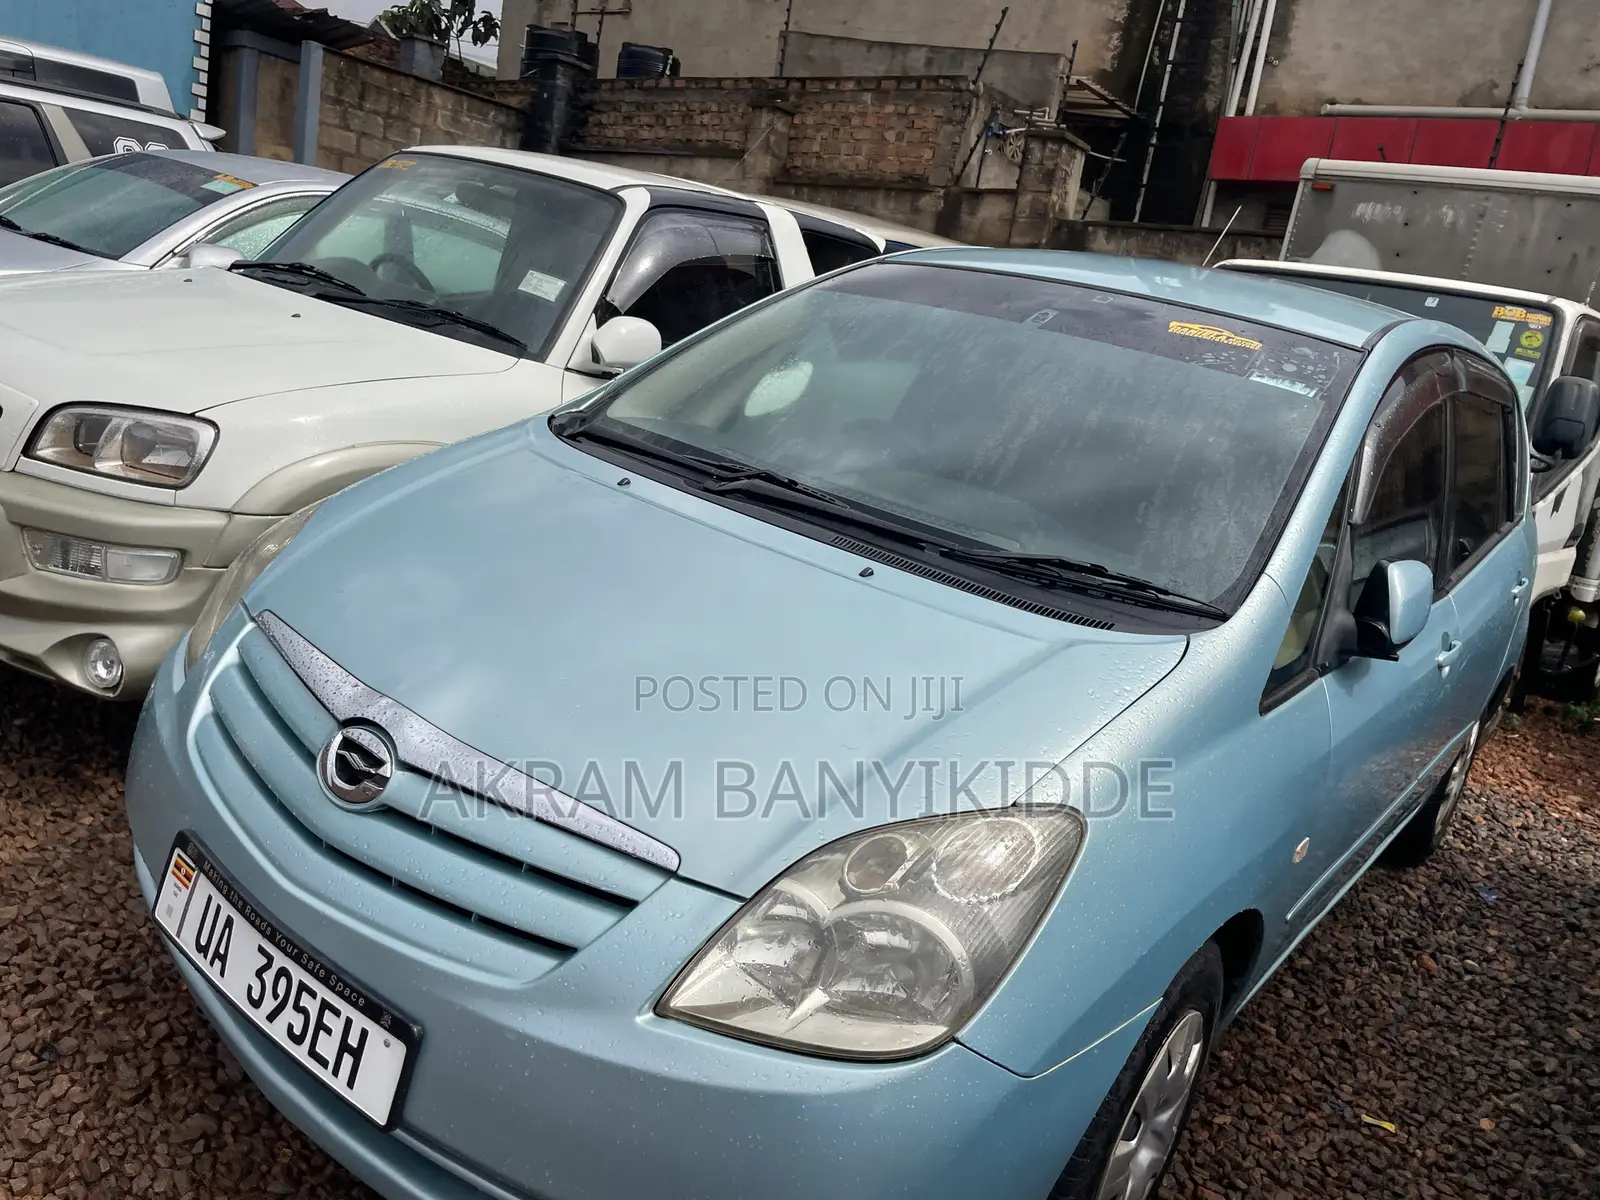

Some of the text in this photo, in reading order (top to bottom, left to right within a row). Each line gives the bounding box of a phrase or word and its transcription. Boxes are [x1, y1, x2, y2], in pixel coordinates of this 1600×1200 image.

[1493, 305, 1527, 319] BOB
[194, 892, 370, 1091] UA 395EH
[202, 860, 229, 895] Making
[229, 890, 243, 909] the
[244, 904, 272, 936] Roads
[275, 931, 299, 956] Your
[300, 953, 326, 978] Safe
[328, 974, 365, 1007] Space
